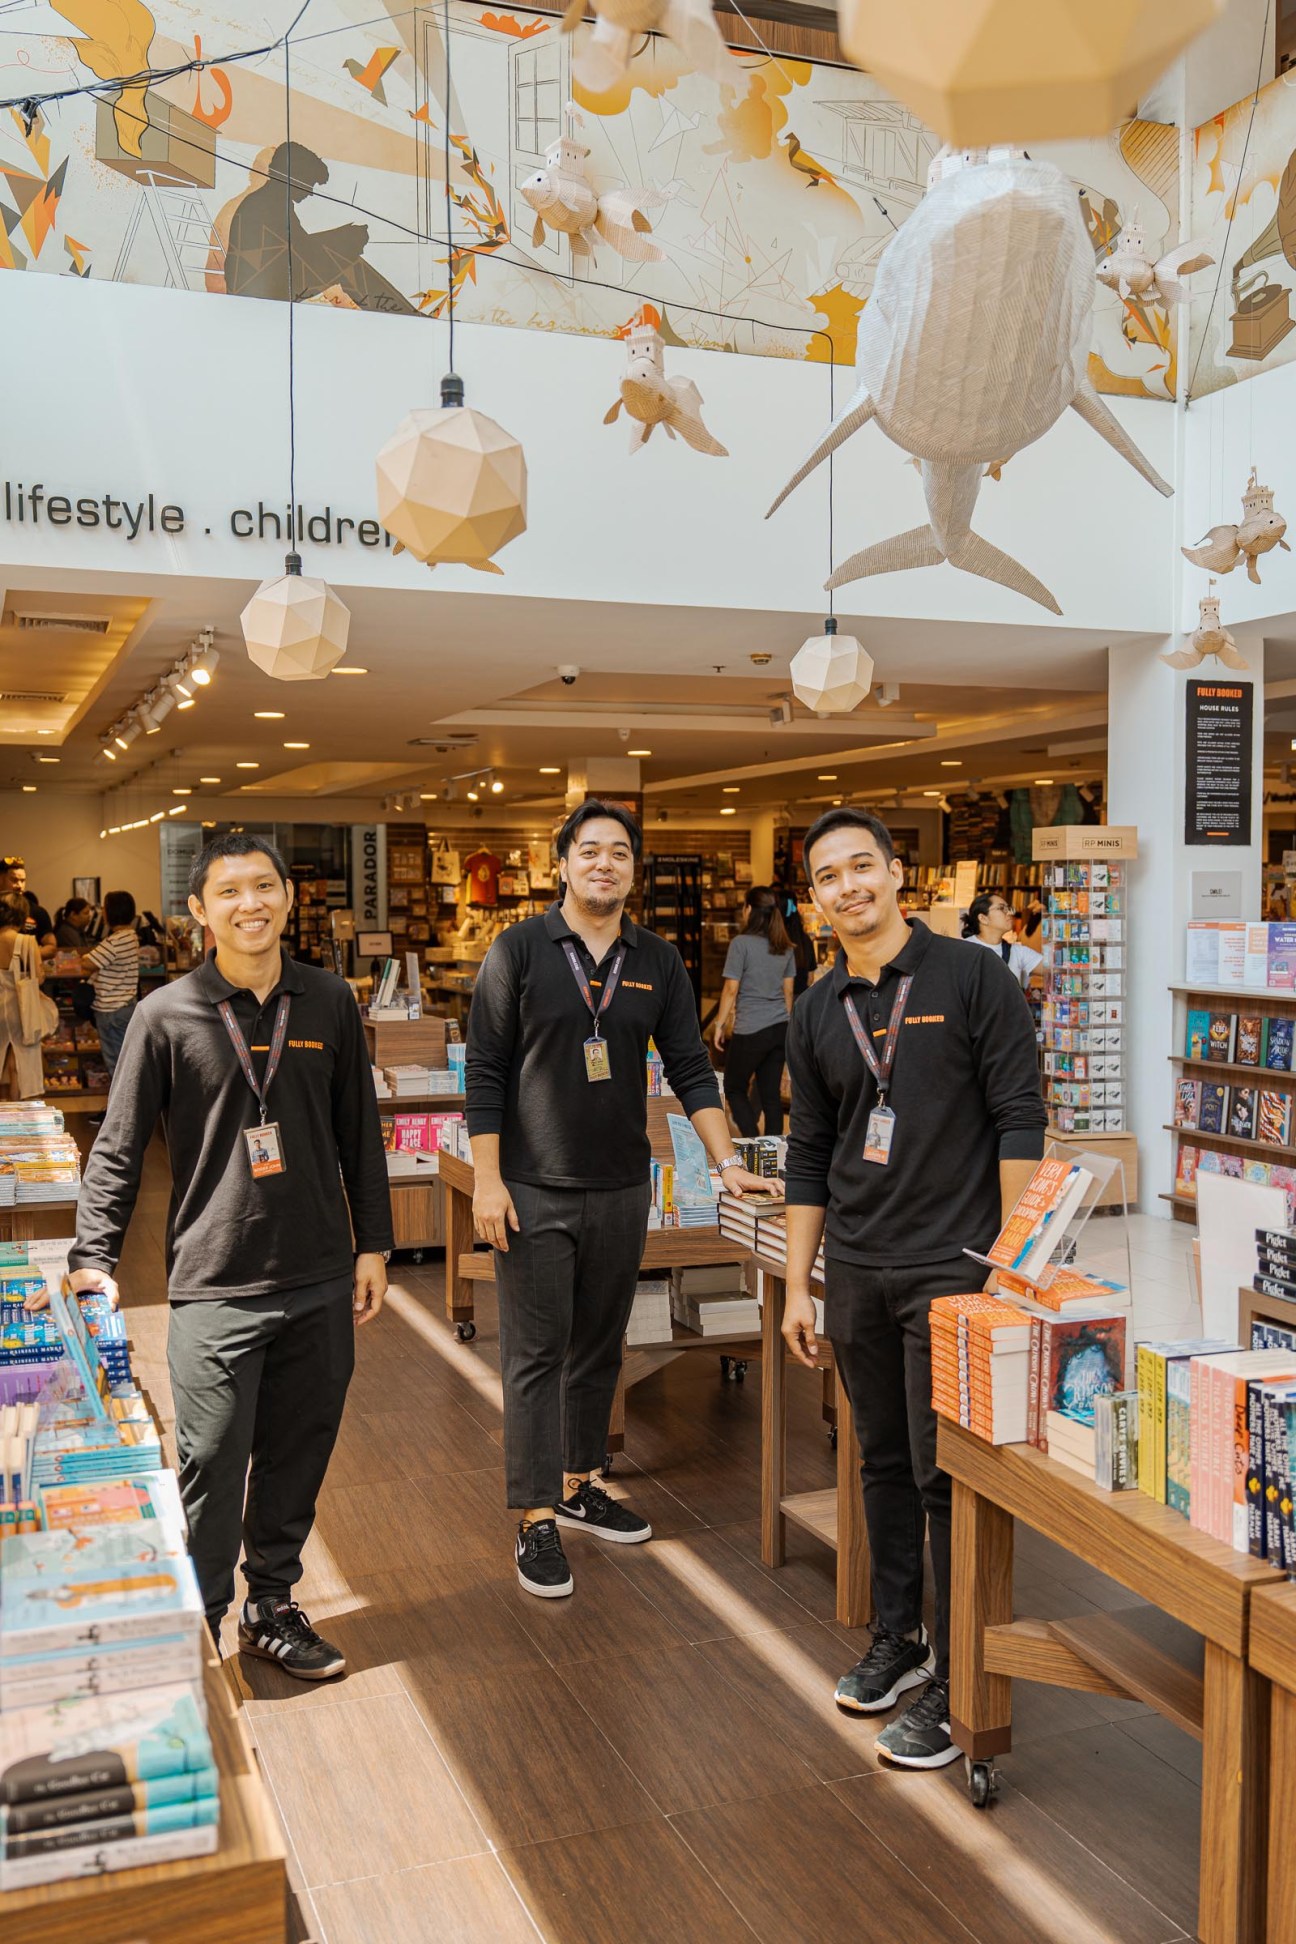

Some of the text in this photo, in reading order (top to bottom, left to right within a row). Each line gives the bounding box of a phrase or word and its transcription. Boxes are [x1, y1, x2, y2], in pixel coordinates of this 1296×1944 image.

[5, 481, 185, 540] lifestyle
[1196, 687, 1243, 698] FULLY BOOKED
[363, 830, 377, 920] PARADOR
[621, 980, 653, 991] FULLY BOOKED
[905, 1015, 945, 1025] FULLY BOOKED
[288, 1040, 323, 1050] FULLY BOOKED
[1210, 1041, 1227, 1049] WITCH
[401, 1129, 422, 1139] HAPPY
[1039, 1161, 1064, 1179] VERA
[1028, 1176, 1058, 1195] WONG'S
[1020, 1192, 1041, 1208] GUIDE
[1266, 1233, 1287, 1248] Piglet
[1267, 1249, 1288, 1264] Piglet
[1269, 1263, 1290, 1279] Piglet
[1262, 1280, 1285, 1297] Piglet
[9, 1348, 38, 1356] RAINFALL
[9, 1357, 38, 1365] RAINFALL
[1029, 1374, 1038, 1404] CROWN
[1041, 1379, 1050, 1408] CROWN
[1118, 1407, 1127, 1484] CARYS DAVIES
[1213, 1435, 1221, 1477] VISIBLE
[1224, 1441, 1232, 1483] VISIBLE
[1234, 1442, 1245, 1476] Cuts
[1283, 1526, 1292, 1564] HARMAN
